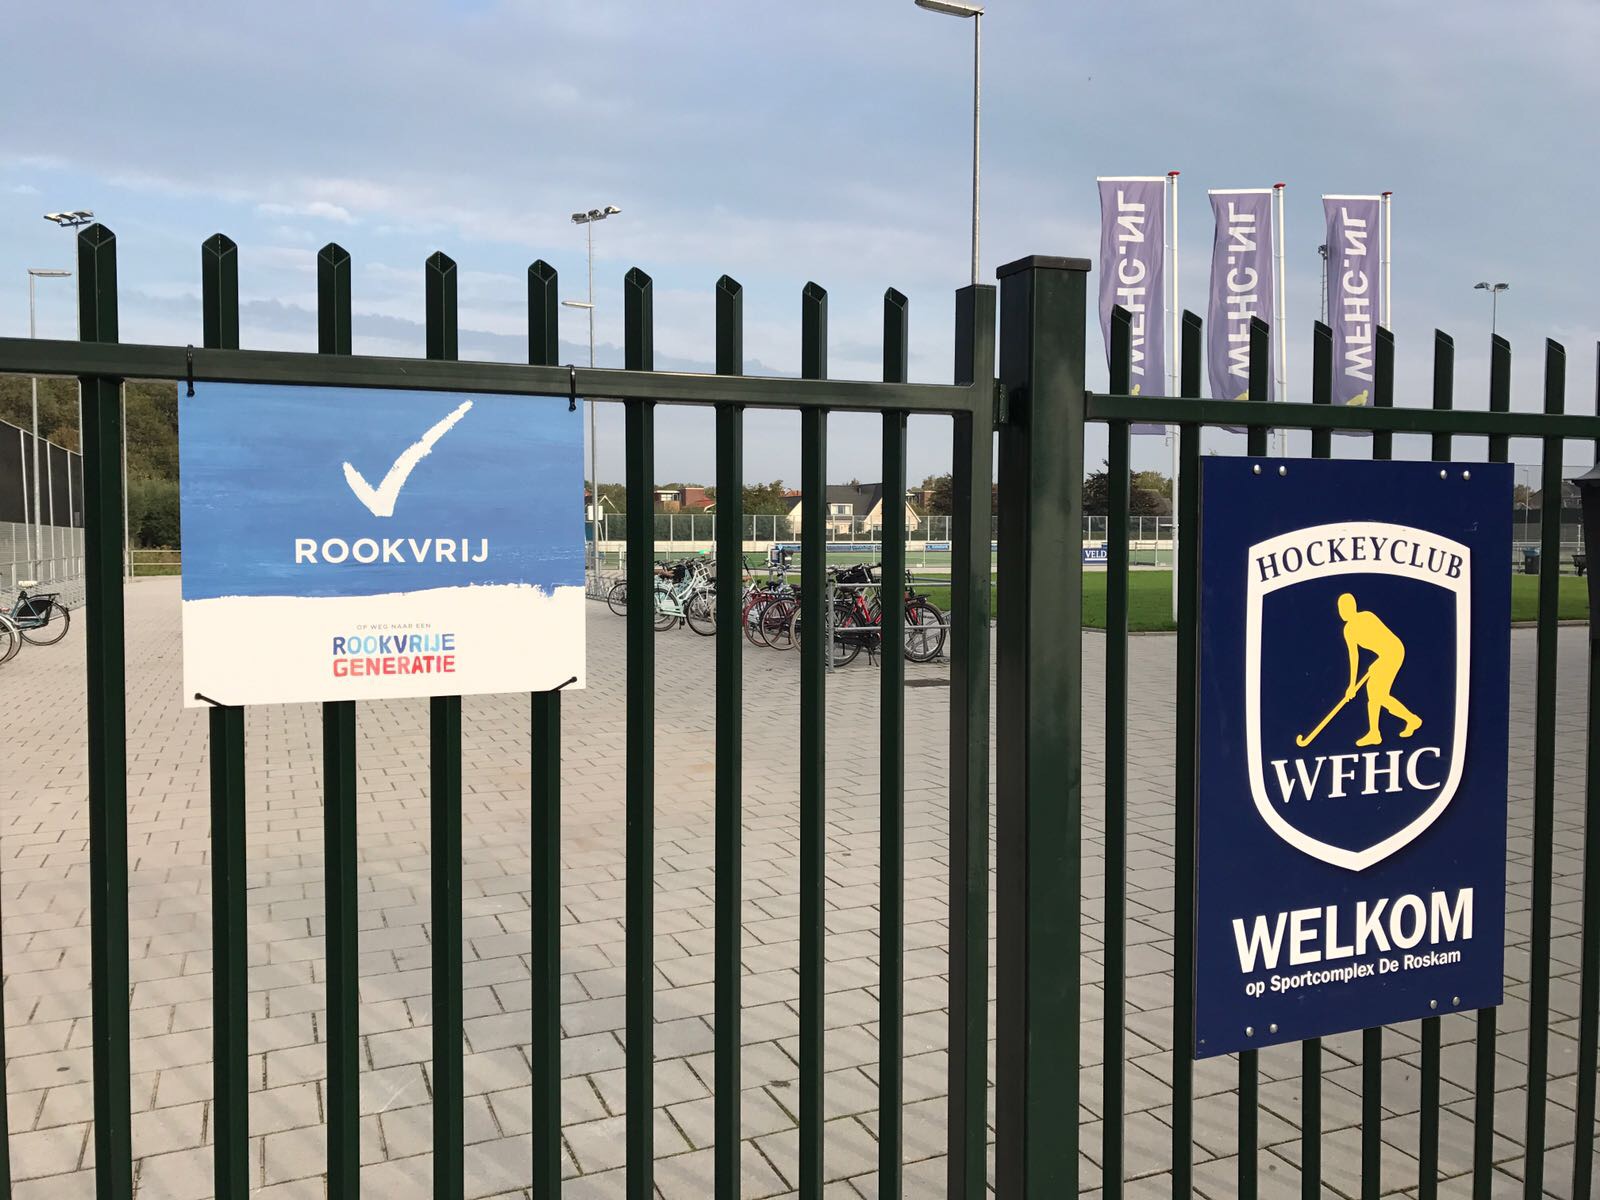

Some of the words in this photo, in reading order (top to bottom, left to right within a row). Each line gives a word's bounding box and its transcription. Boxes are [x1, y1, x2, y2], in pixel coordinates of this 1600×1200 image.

[294, 538, 489, 564] ROOKVRIJ
[1256, 536, 1463, 582] HOCKEYCLUB
[332, 633, 456, 656] ROOKVRIJE
[332, 655, 456, 677] GENERATIE
[1270, 747, 1441, 804] WFHC
[1232, 887, 1474, 974] WELKOM
[1245, 979, 1266, 998] op
[1270, 963, 1375, 994] Sportcomplex
[1379, 957, 1399, 975] De
[1404, 950, 1461, 970] Roskam
